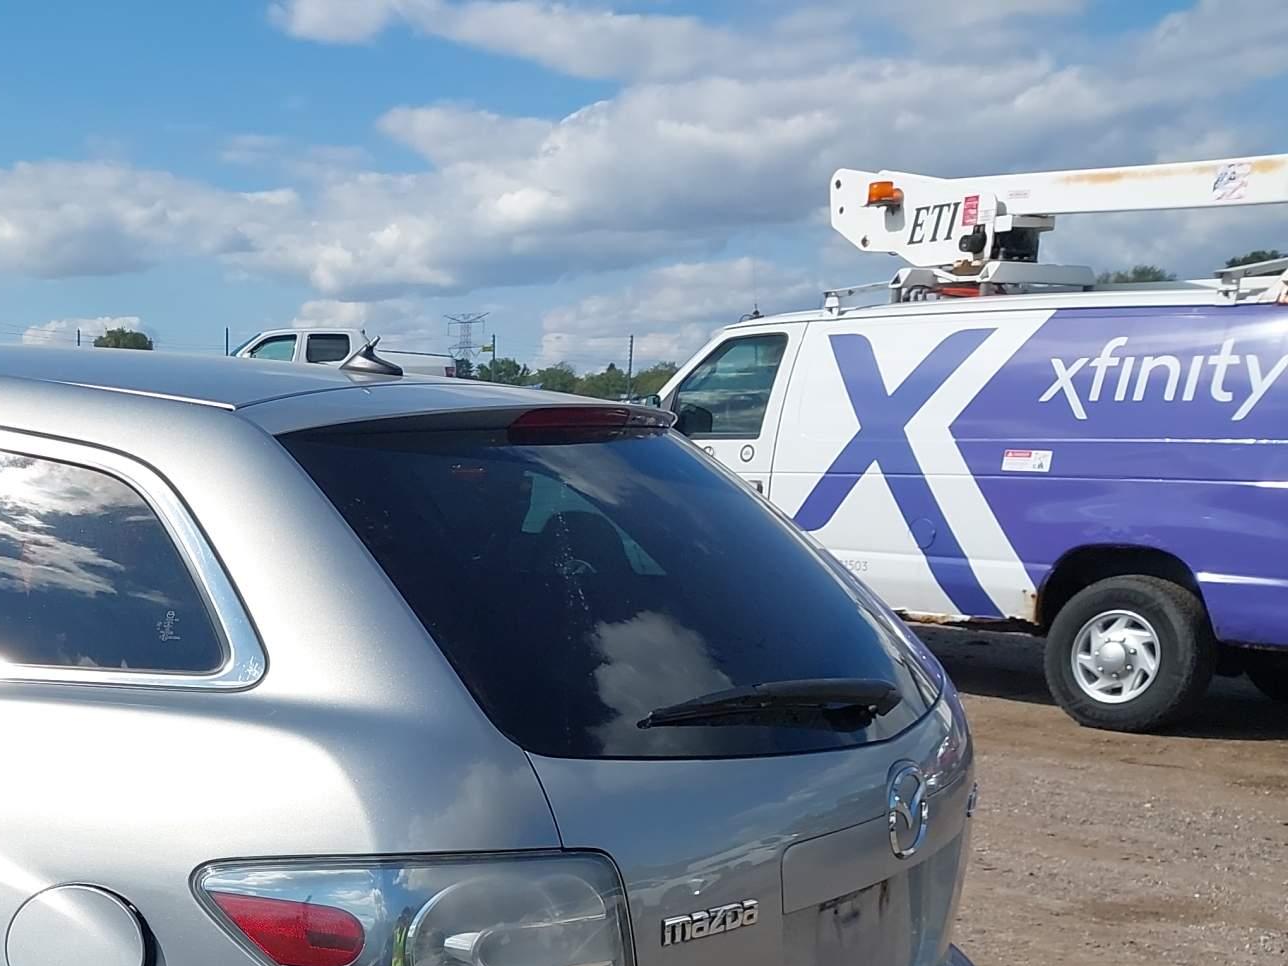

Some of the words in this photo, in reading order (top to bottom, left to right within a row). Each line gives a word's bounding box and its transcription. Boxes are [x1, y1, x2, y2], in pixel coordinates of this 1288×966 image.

[907, 201, 962, 245] ETI
[1039, 336, 1288, 421] xfinity
[839, 559, 868, 572] 1503
